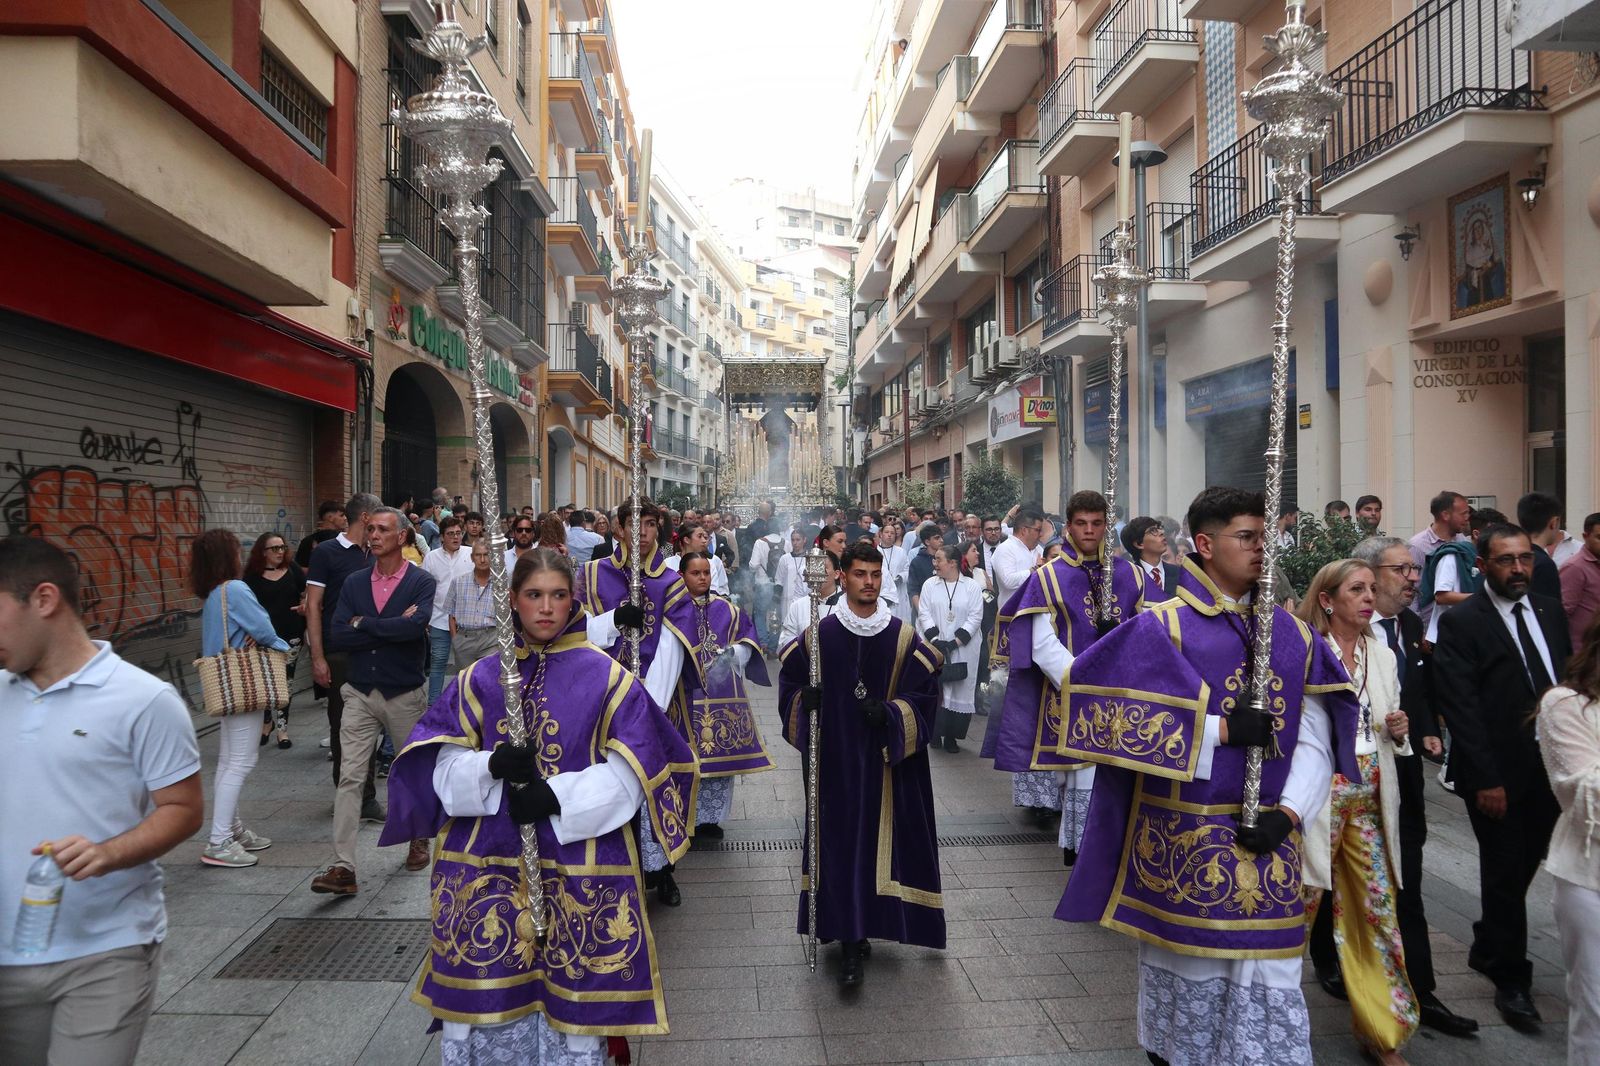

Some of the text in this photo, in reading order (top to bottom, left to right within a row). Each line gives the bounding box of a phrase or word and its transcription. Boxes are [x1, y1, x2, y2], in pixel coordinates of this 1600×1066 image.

[1433, 339, 1500, 355] EDIFICIO
[1413, 354, 1524, 372] VIRGEN DE LA
[1457, 389, 1479, 403] XV
